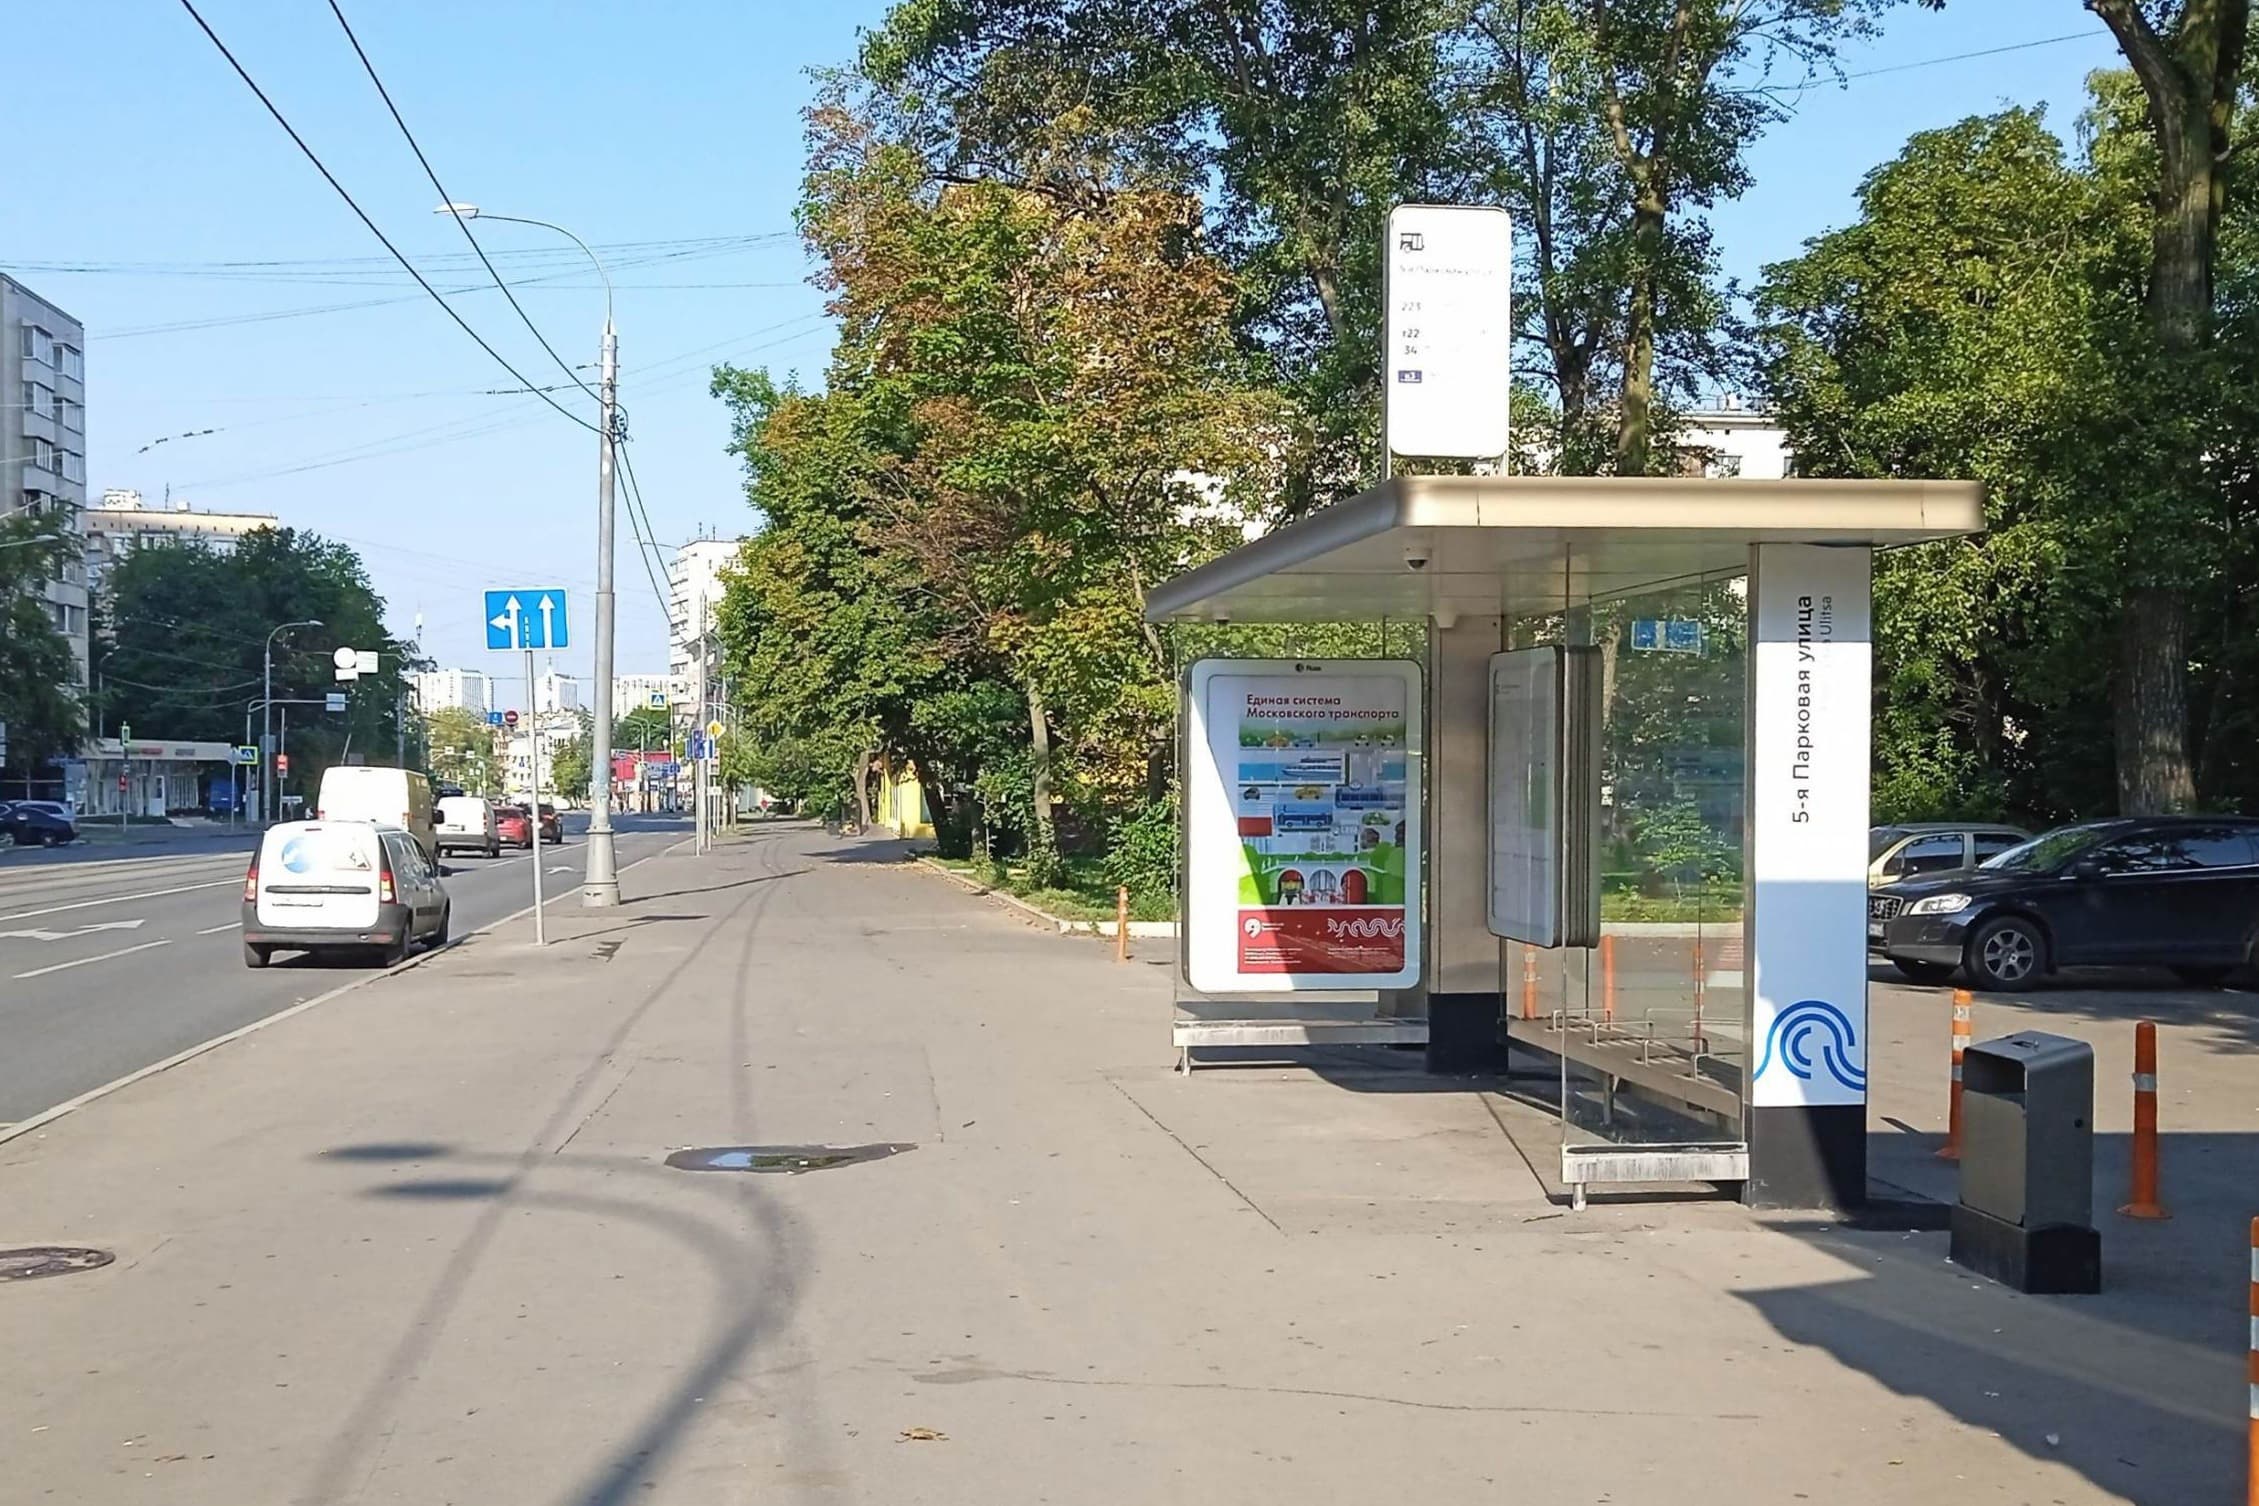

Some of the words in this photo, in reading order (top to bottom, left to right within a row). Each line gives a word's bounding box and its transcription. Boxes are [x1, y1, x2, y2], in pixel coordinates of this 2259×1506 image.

[1404, 344, 1418, 355] 34
[1797, 596, 1814, 662] улица
[1819, 596, 1832, 636] Ulitsa
[1246, 694, 1290, 706] Единая
[1293, 696, 1341, 706] система
[1246, 707, 1326, 719] Московского
[1328, 709, 1399, 721] транспорта
[1792, 670, 1813, 780] Парковая
[1792, 788, 1809, 824] 5-я
